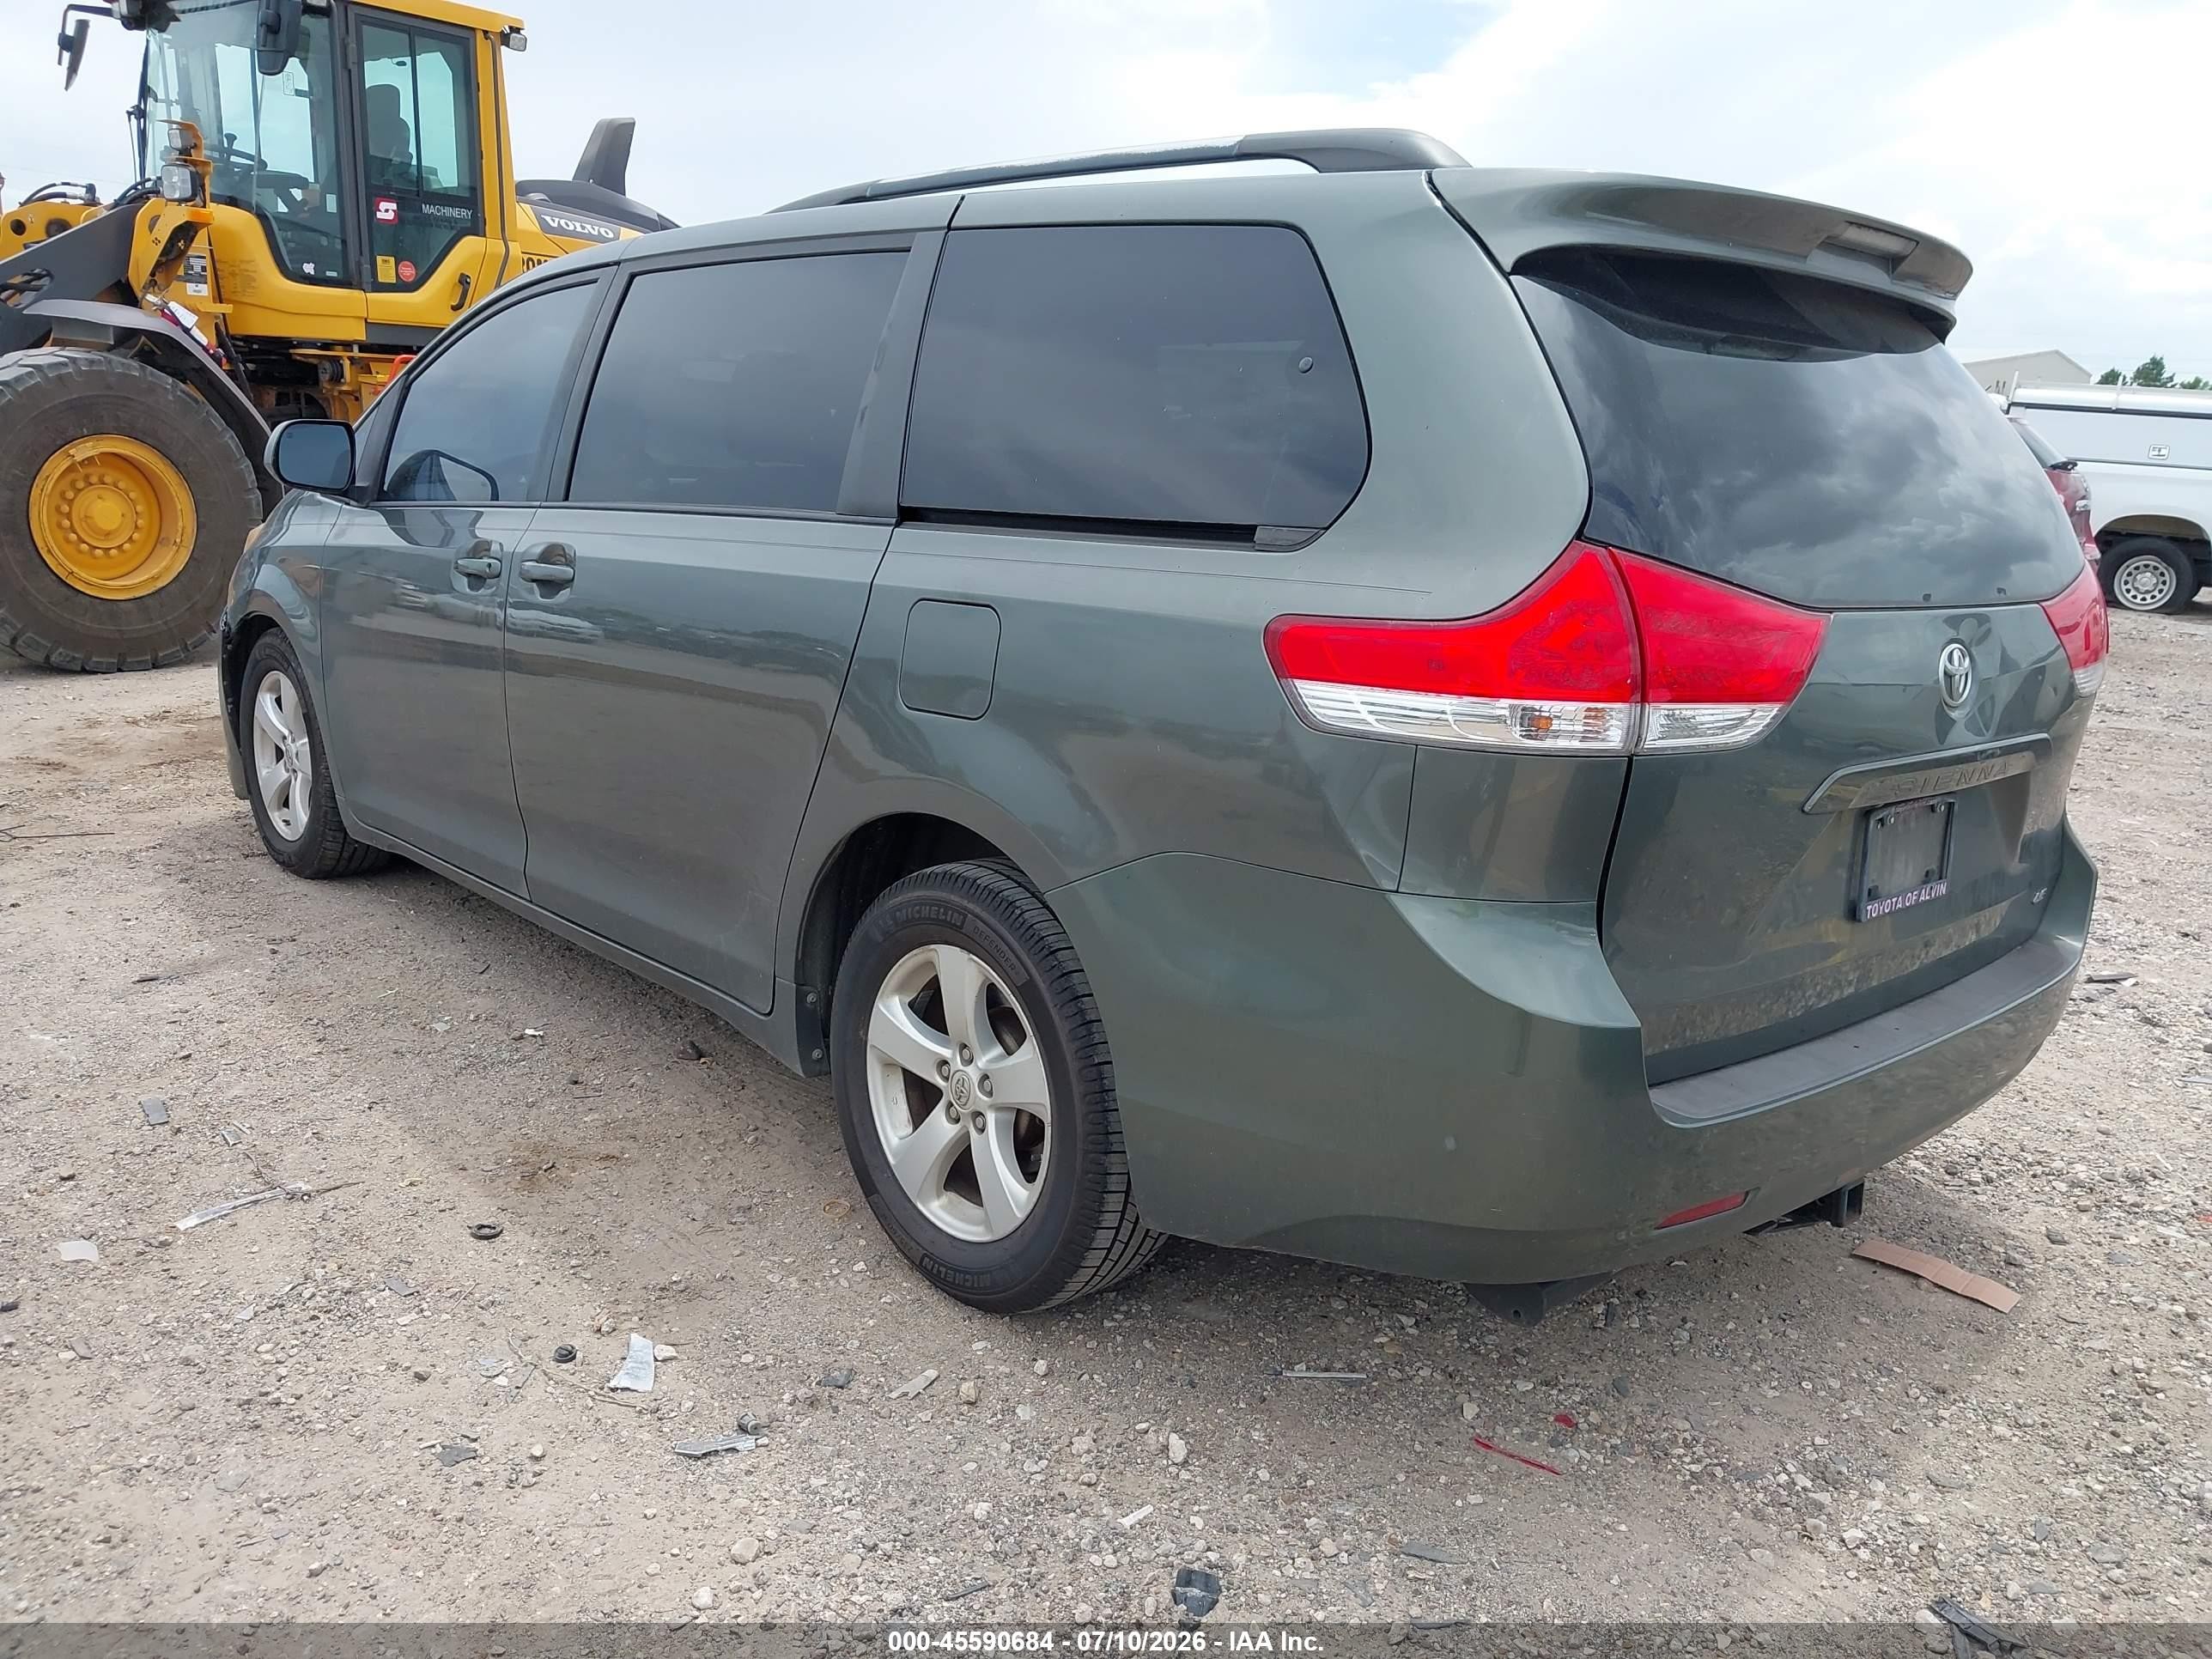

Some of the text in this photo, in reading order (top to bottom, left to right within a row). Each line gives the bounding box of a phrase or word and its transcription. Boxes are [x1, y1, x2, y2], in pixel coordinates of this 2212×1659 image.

[422, 204, 473, 219] MACHINERY
[540, 214, 614, 239] VOLVO
[1891, 762, 2008, 795] SIENNA
[896, 905, 964, 927] MICHELIN
[1867, 882, 1948, 920] TOYOTA OF ALVIN
[972, 926, 1017, 971] DEFENDER
[922, 1255, 992, 1287] MICHELIN
